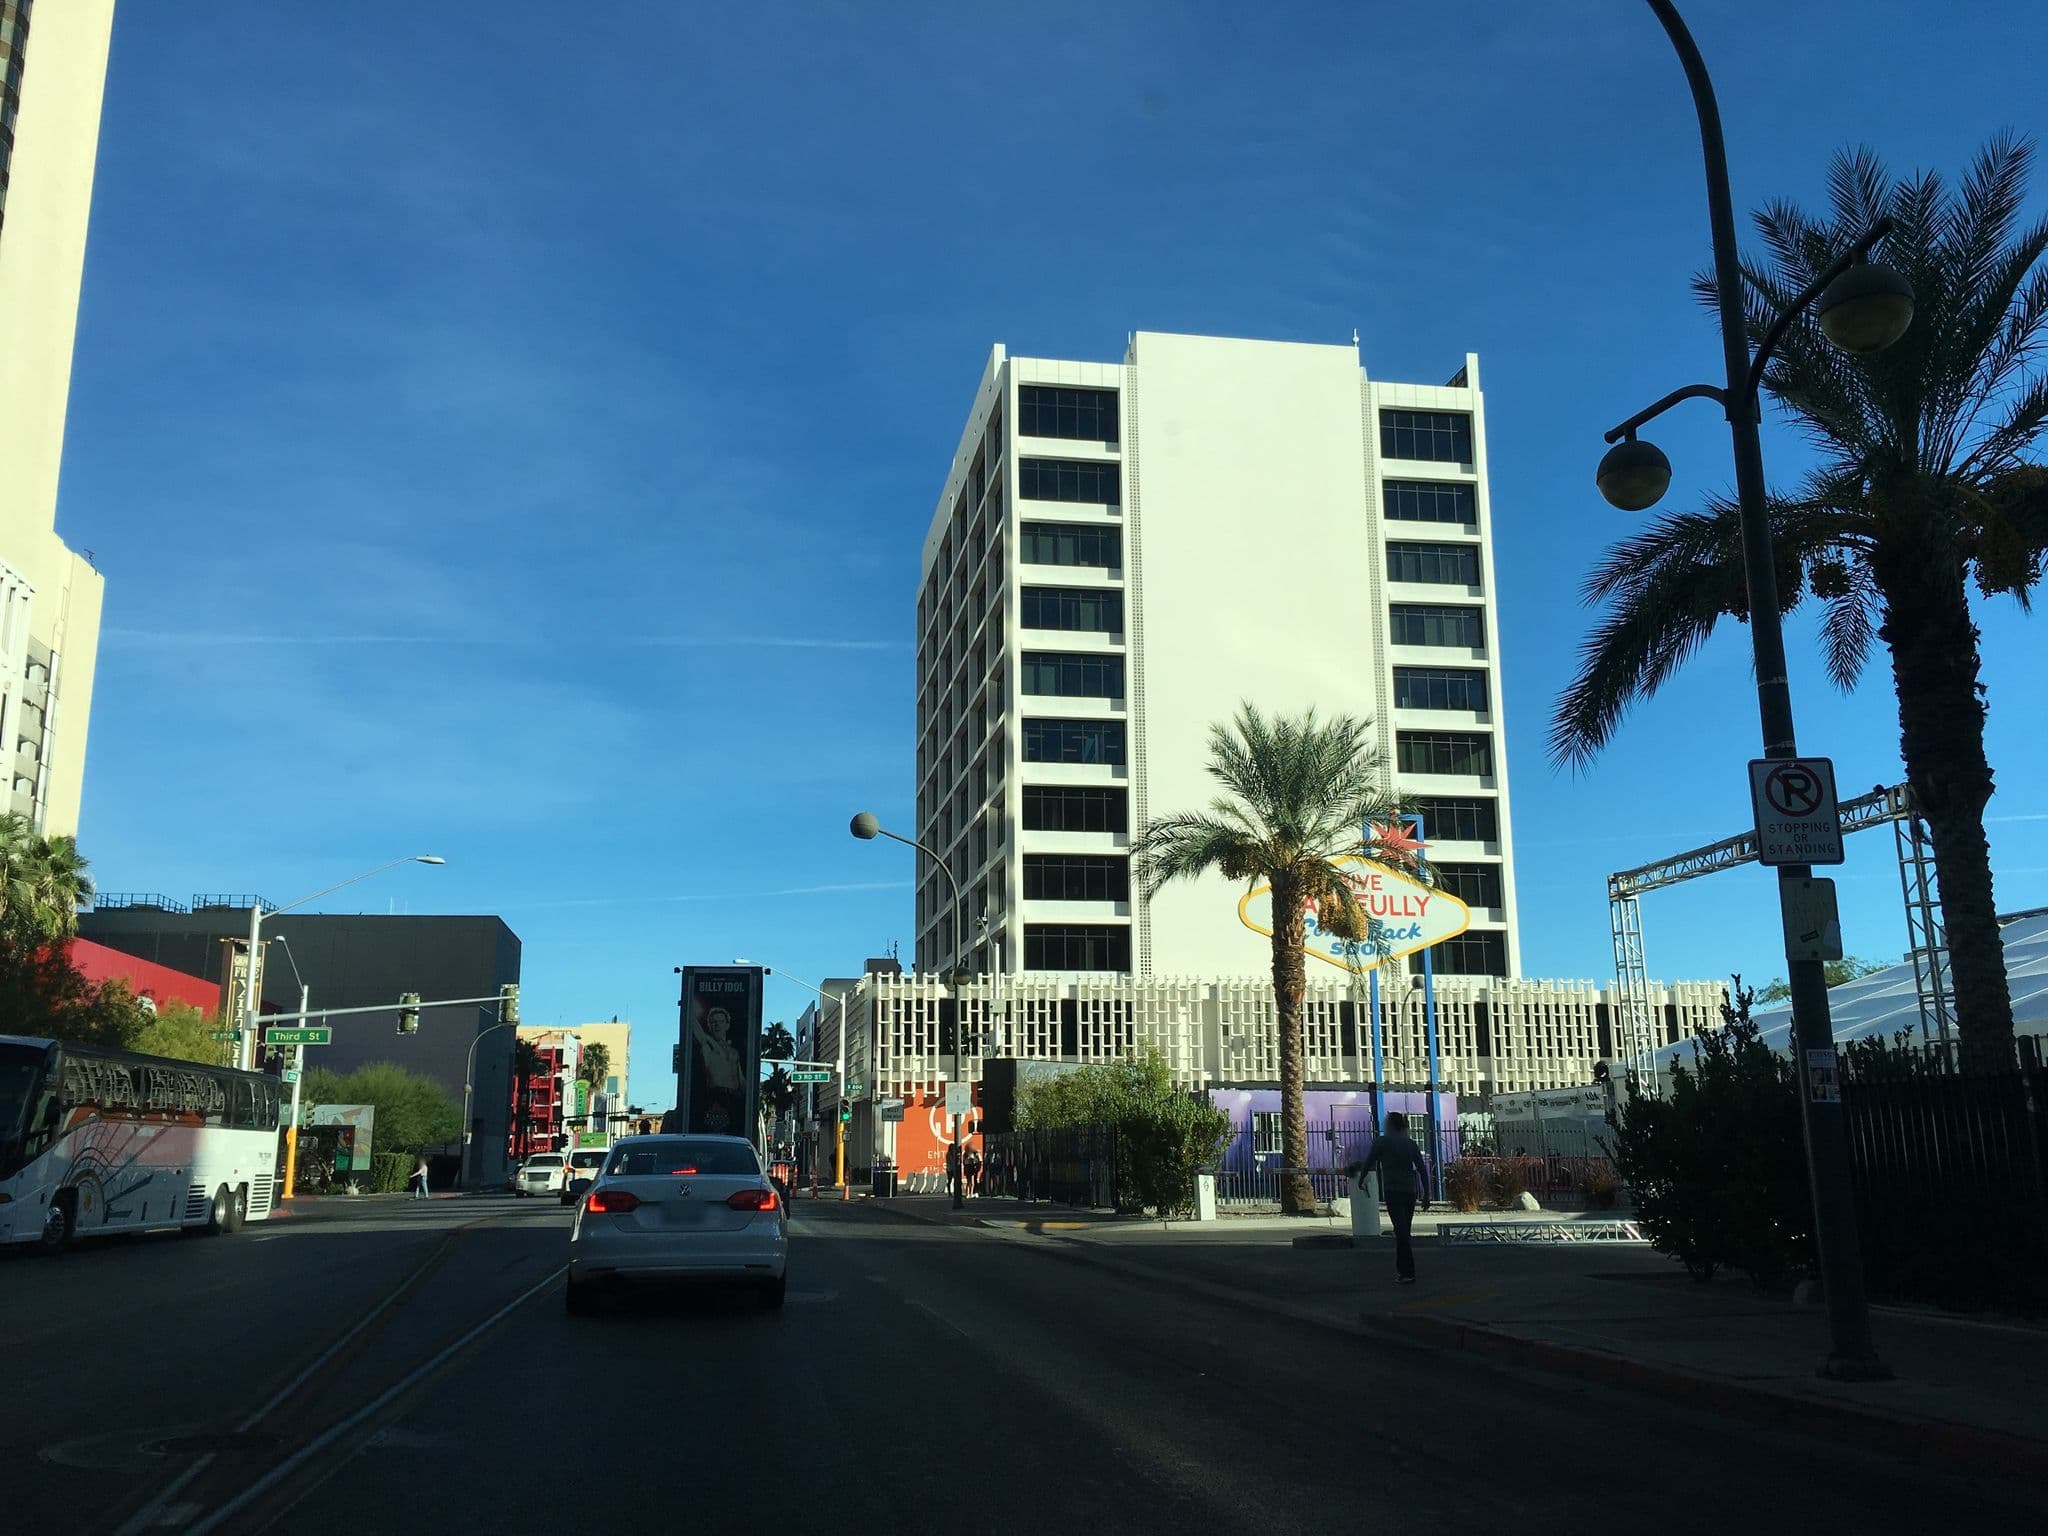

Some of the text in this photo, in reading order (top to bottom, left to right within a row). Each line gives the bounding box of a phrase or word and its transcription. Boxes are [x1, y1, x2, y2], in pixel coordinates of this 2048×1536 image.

[1768, 822, 1830, 833] STOPPING
[1793, 833, 1808, 842] OR
[1768, 843, 1835, 855] STANDING
[699, 981, 724, 993] BILLY
[274, 1032, 320, 1041] Third St
